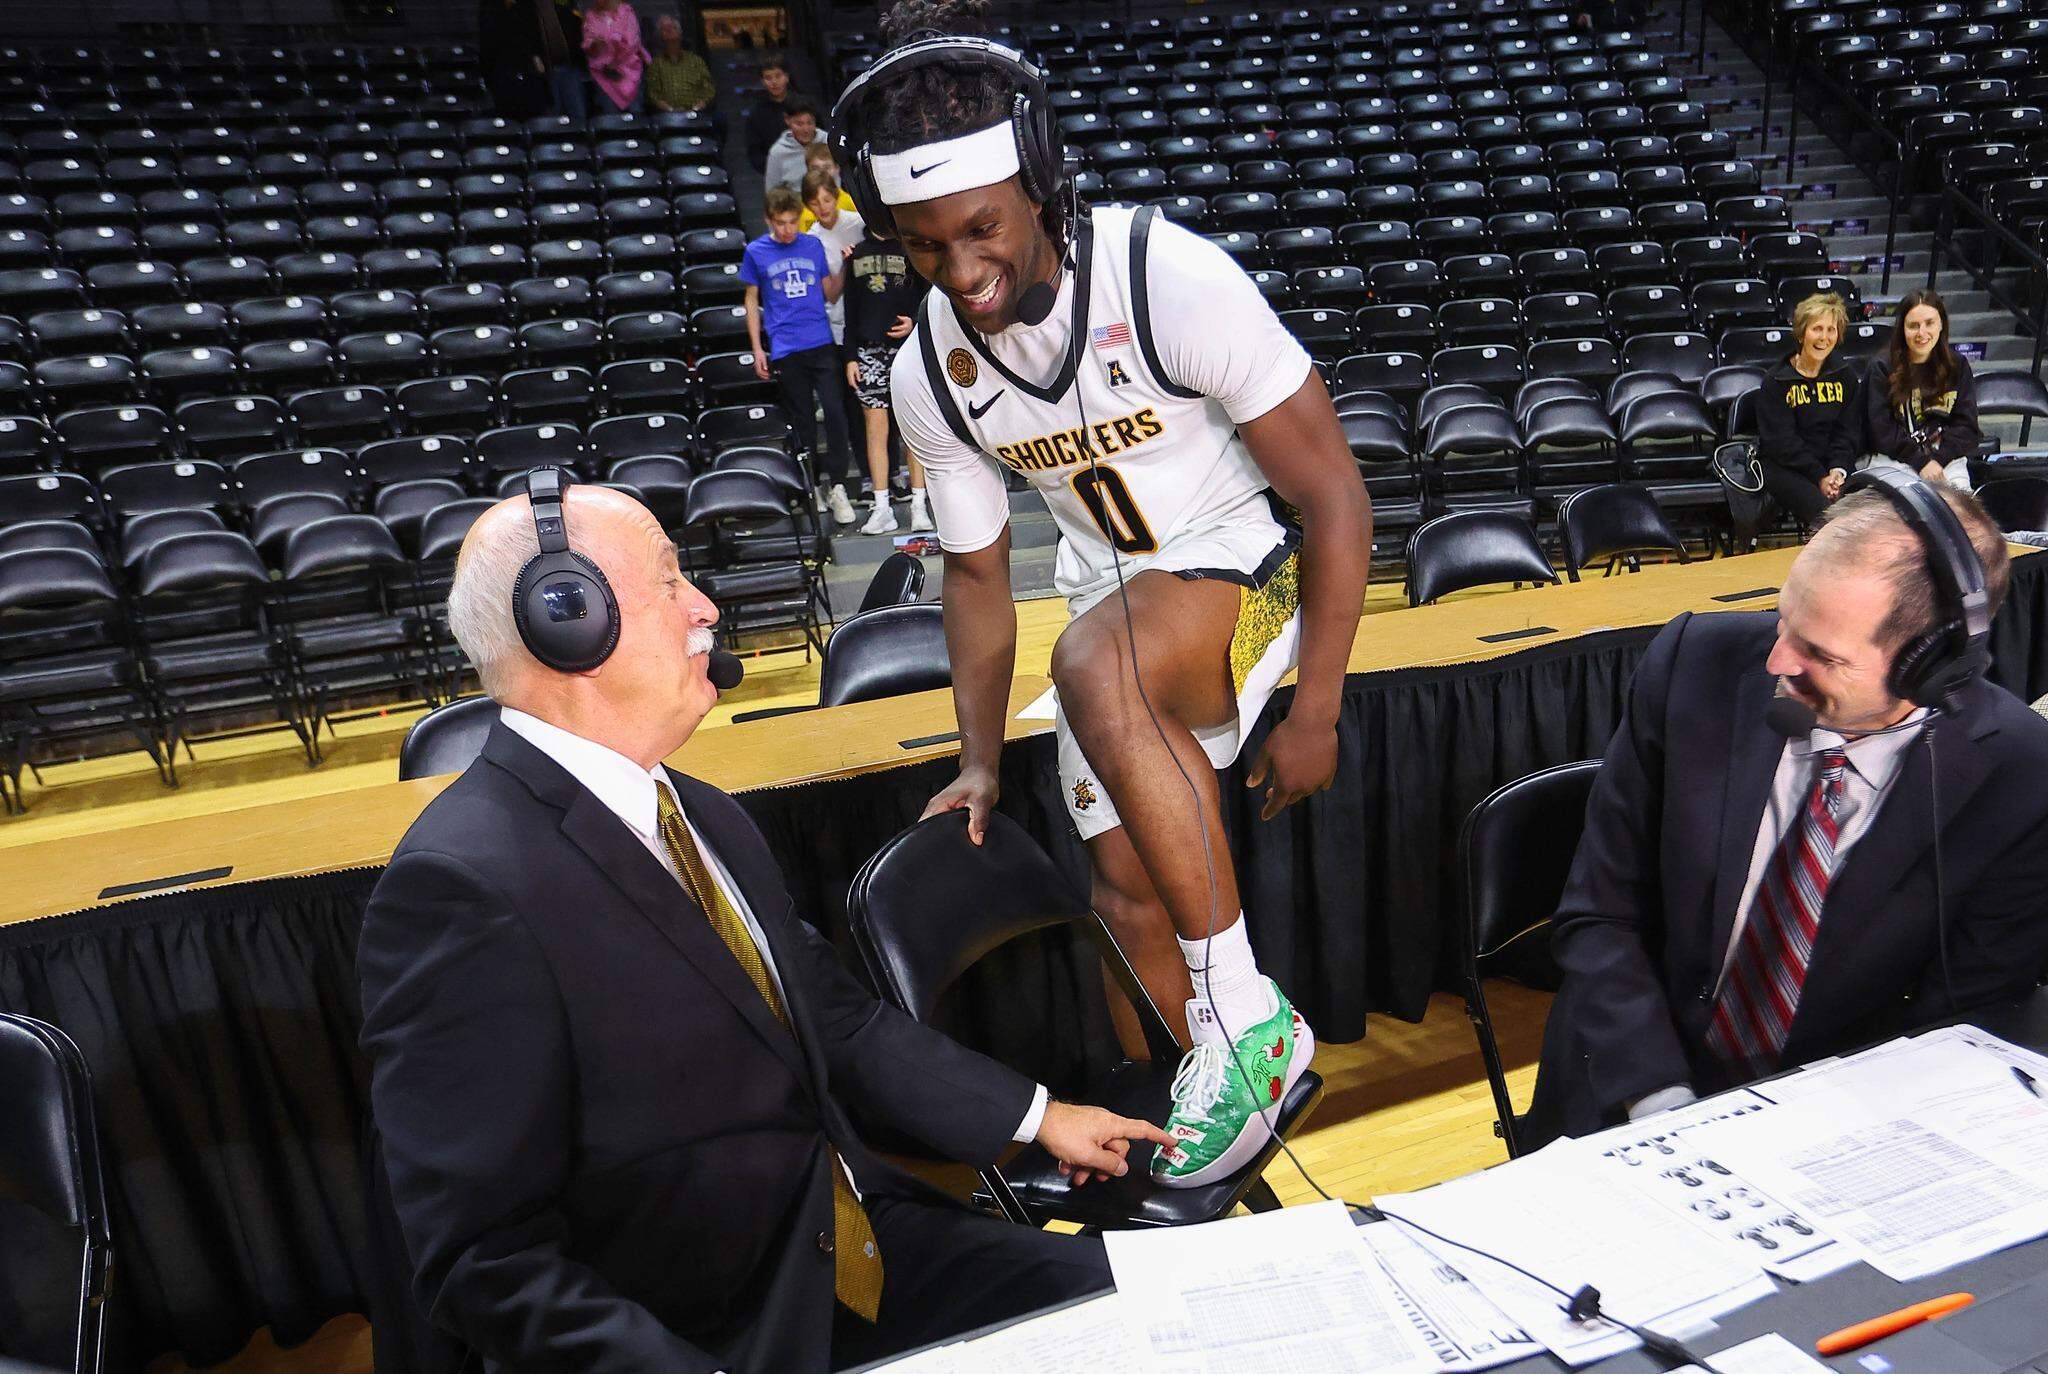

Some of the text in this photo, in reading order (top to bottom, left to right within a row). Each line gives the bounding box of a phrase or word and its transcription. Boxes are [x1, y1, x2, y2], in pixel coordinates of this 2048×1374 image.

[1106, 360, 1131, 387] A
[996, 407, 1165, 471] SHOCKERS
[1069, 463, 1159, 556] 0
